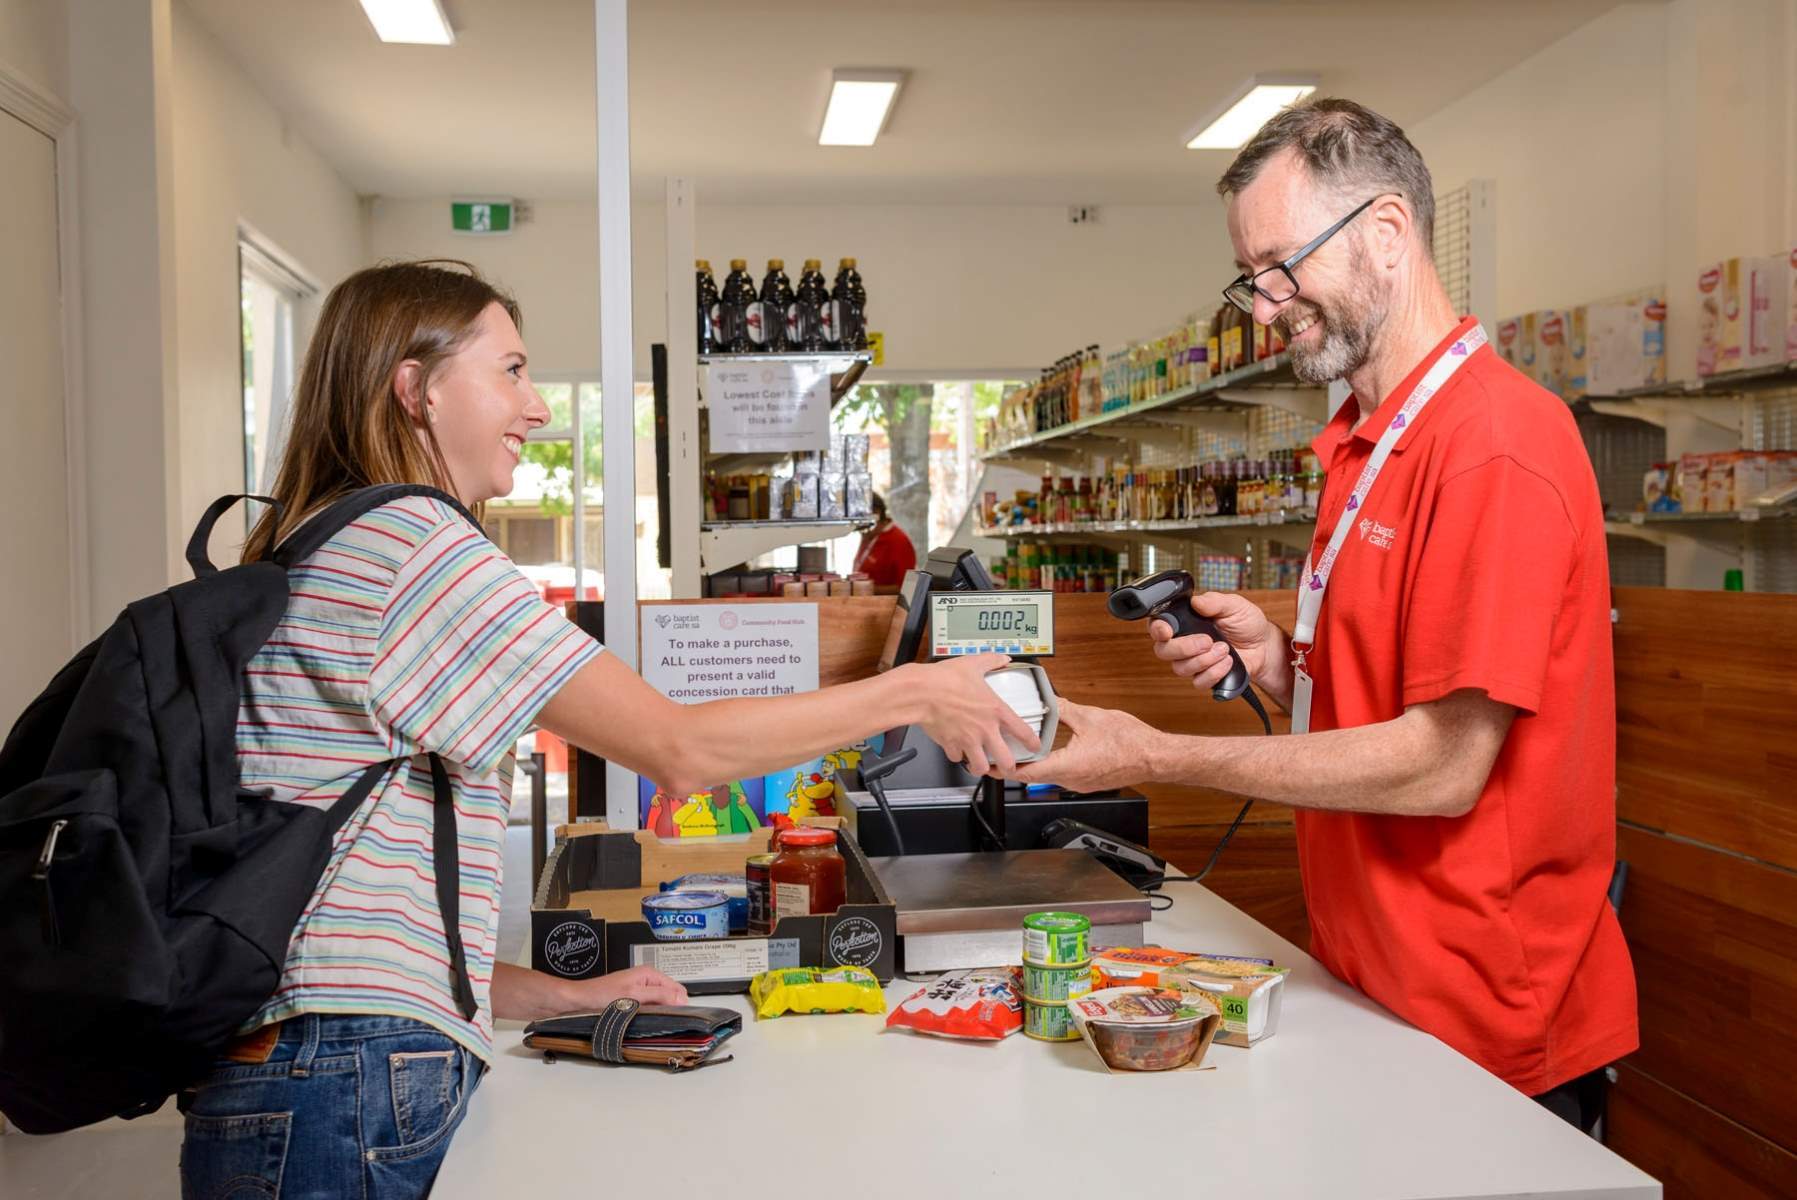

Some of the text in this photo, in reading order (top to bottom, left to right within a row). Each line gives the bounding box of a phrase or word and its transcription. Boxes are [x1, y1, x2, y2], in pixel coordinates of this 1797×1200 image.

[724, 390, 760, 400] Lowest
[748, 416, 766, 425] this
[673, 614, 700, 624] baptist
[978, 611, 1038, 635] 0.002 kg
[668, 637, 793, 650] To make a purchase,
[661, 654, 801, 666] ALL customers need to
[688, 671, 733, 684] present
[747, 669, 776, 681] valid
[668, 684, 795, 698] concession card that
[656, 914, 702, 926] SAFCOL
[548, 935, 597, 962] Perfection
[832, 931, 879, 956] Perfection
[1227, 1003, 1244, 1015] 40
